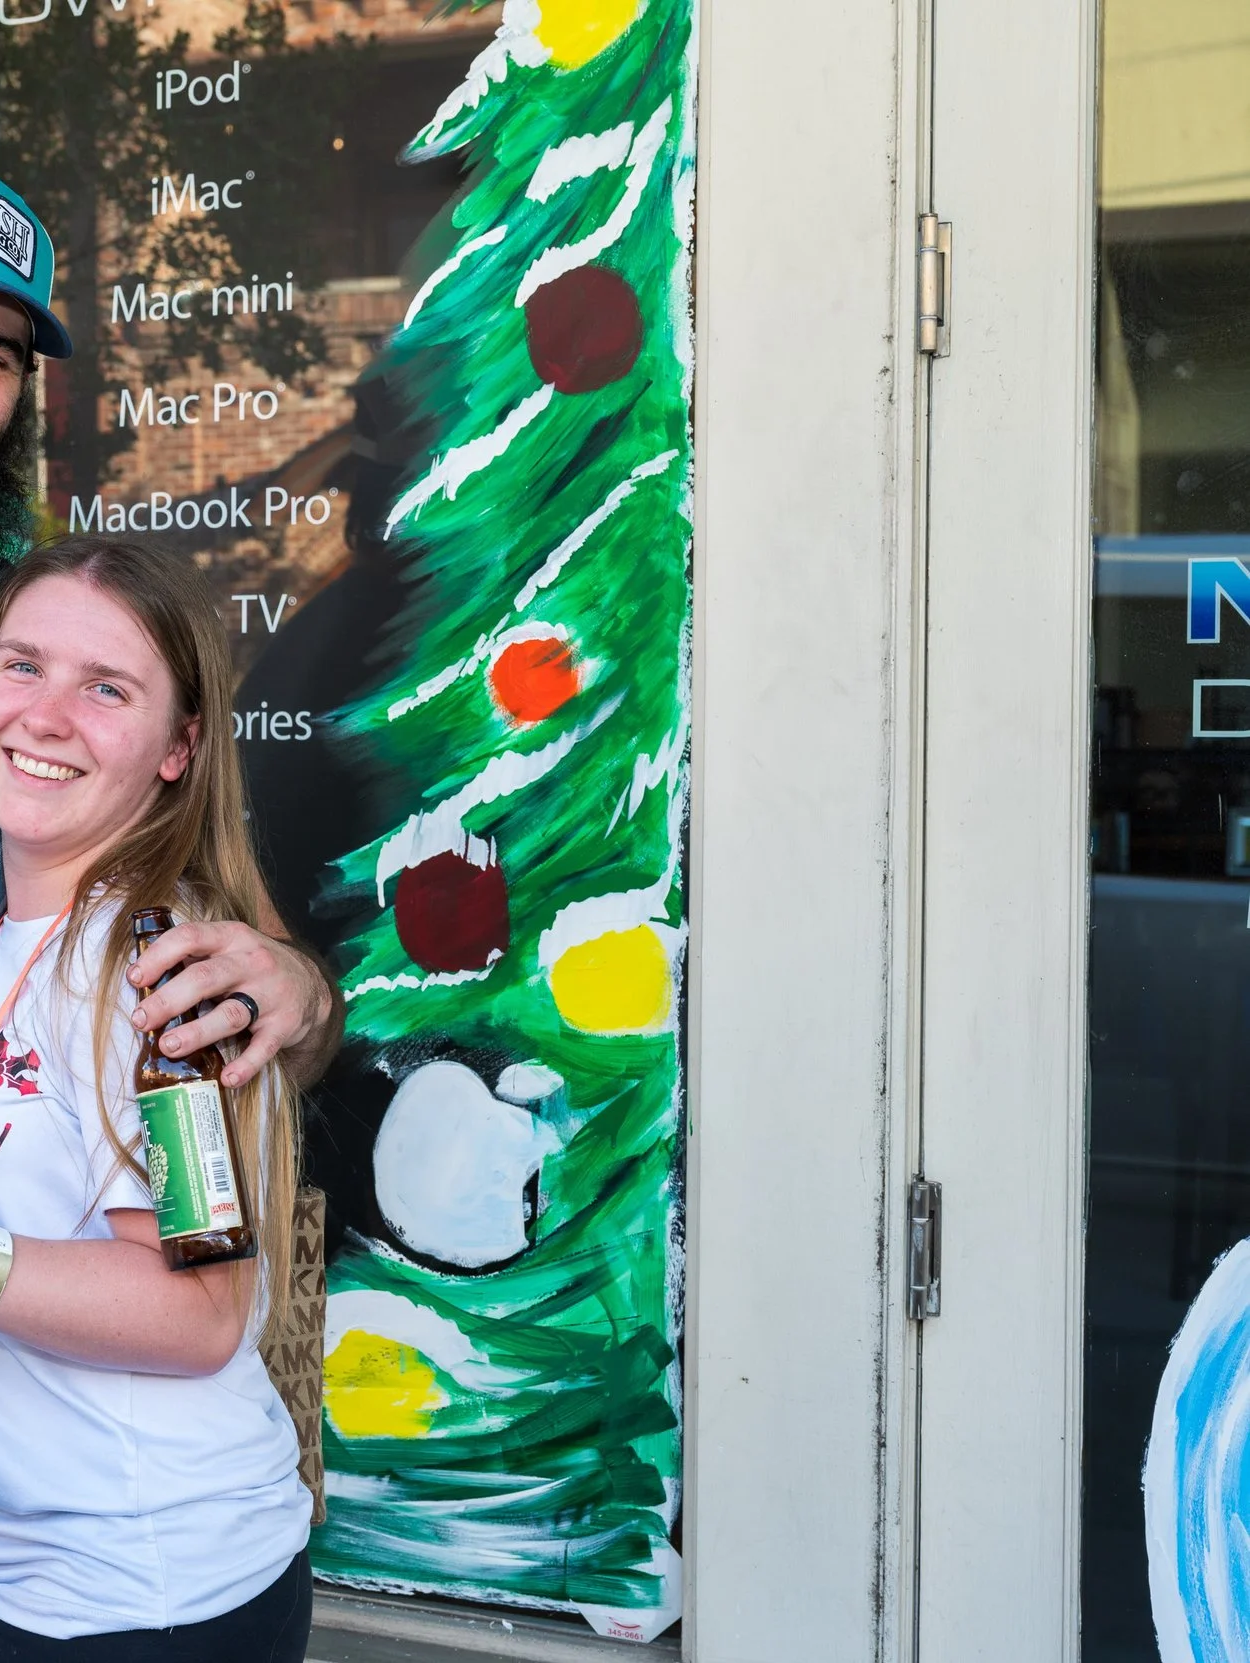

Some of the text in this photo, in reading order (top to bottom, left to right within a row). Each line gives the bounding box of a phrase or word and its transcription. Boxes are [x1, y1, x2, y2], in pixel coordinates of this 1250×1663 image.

[155, 60, 241, 110] iPod
[150, 172, 243, 216] iMac
[110, 272, 294, 324] Mac mini
[119, 383, 278, 428] Mac Pro
[69, 486, 331, 533] MacBook Pro
[231, 594, 288, 634] TV
